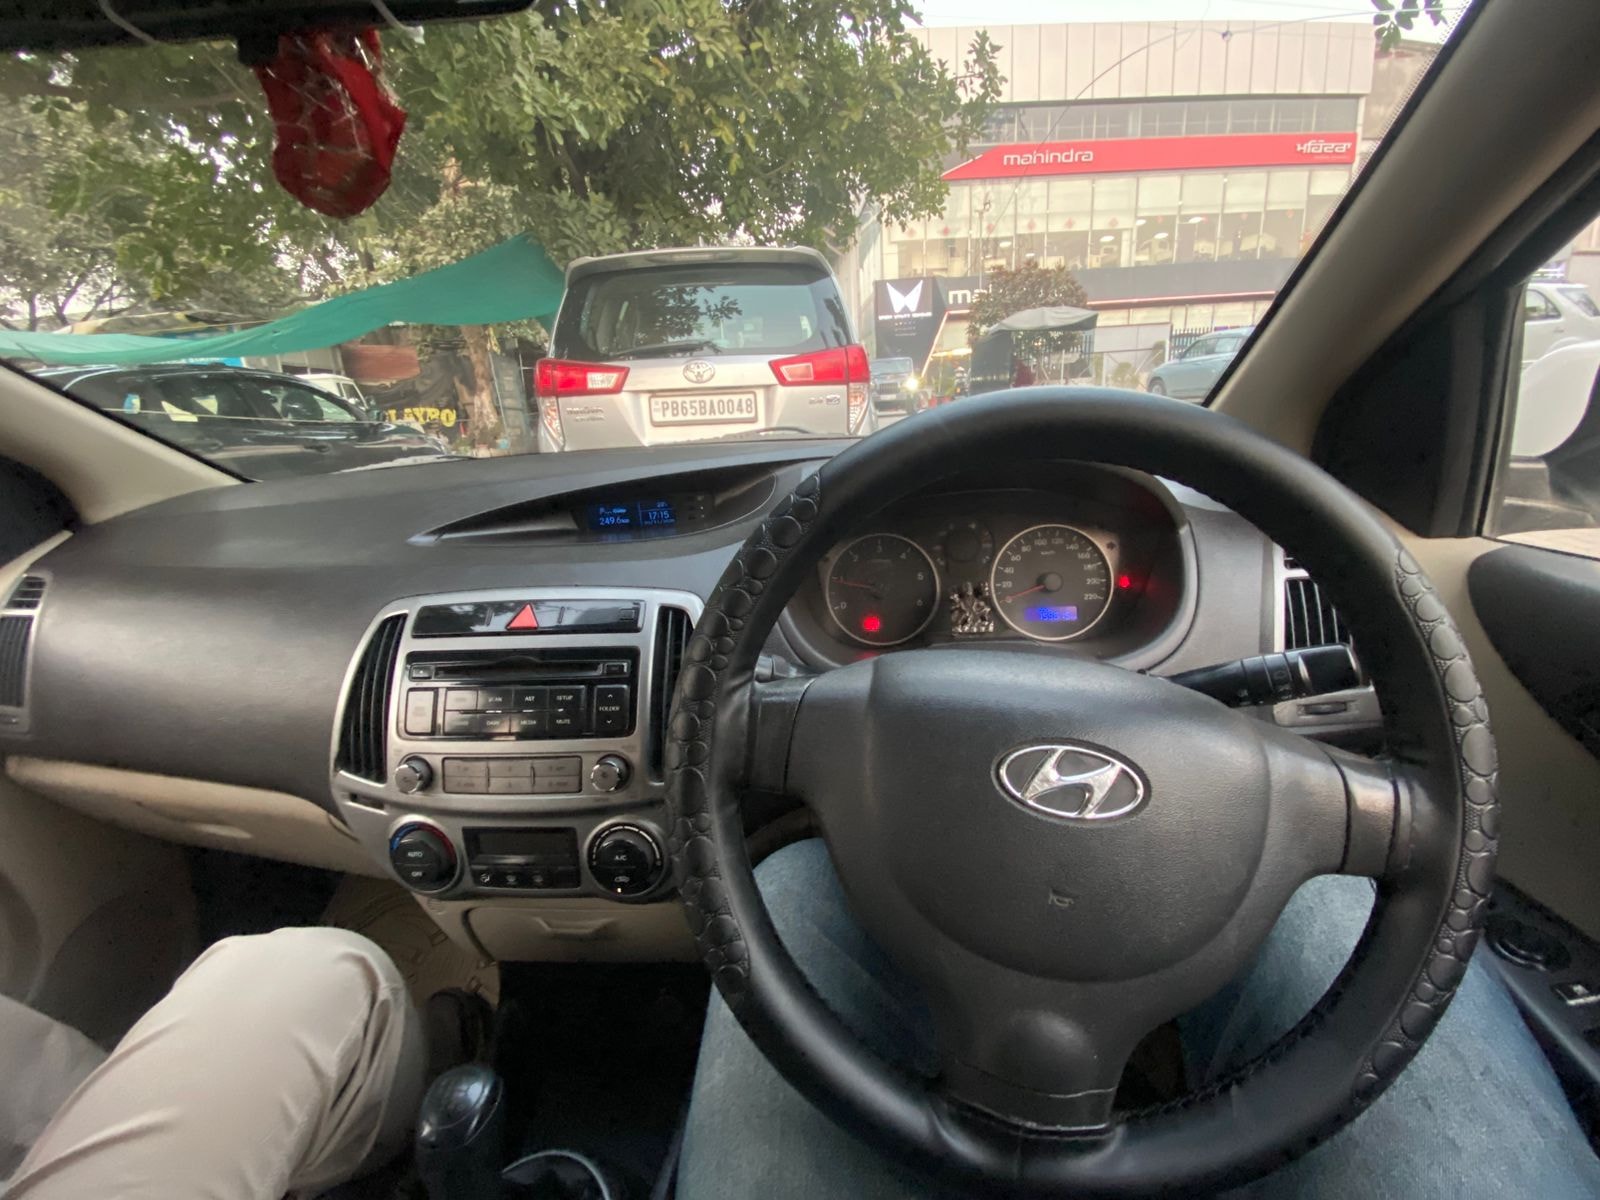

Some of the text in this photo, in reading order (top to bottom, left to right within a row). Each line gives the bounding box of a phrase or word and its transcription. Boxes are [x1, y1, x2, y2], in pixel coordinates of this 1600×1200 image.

[1003, 148, 1094, 166] mahindra
[661, 398, 753, 418] PB65BA0048
[1004, 566, 1014, 574] 40
